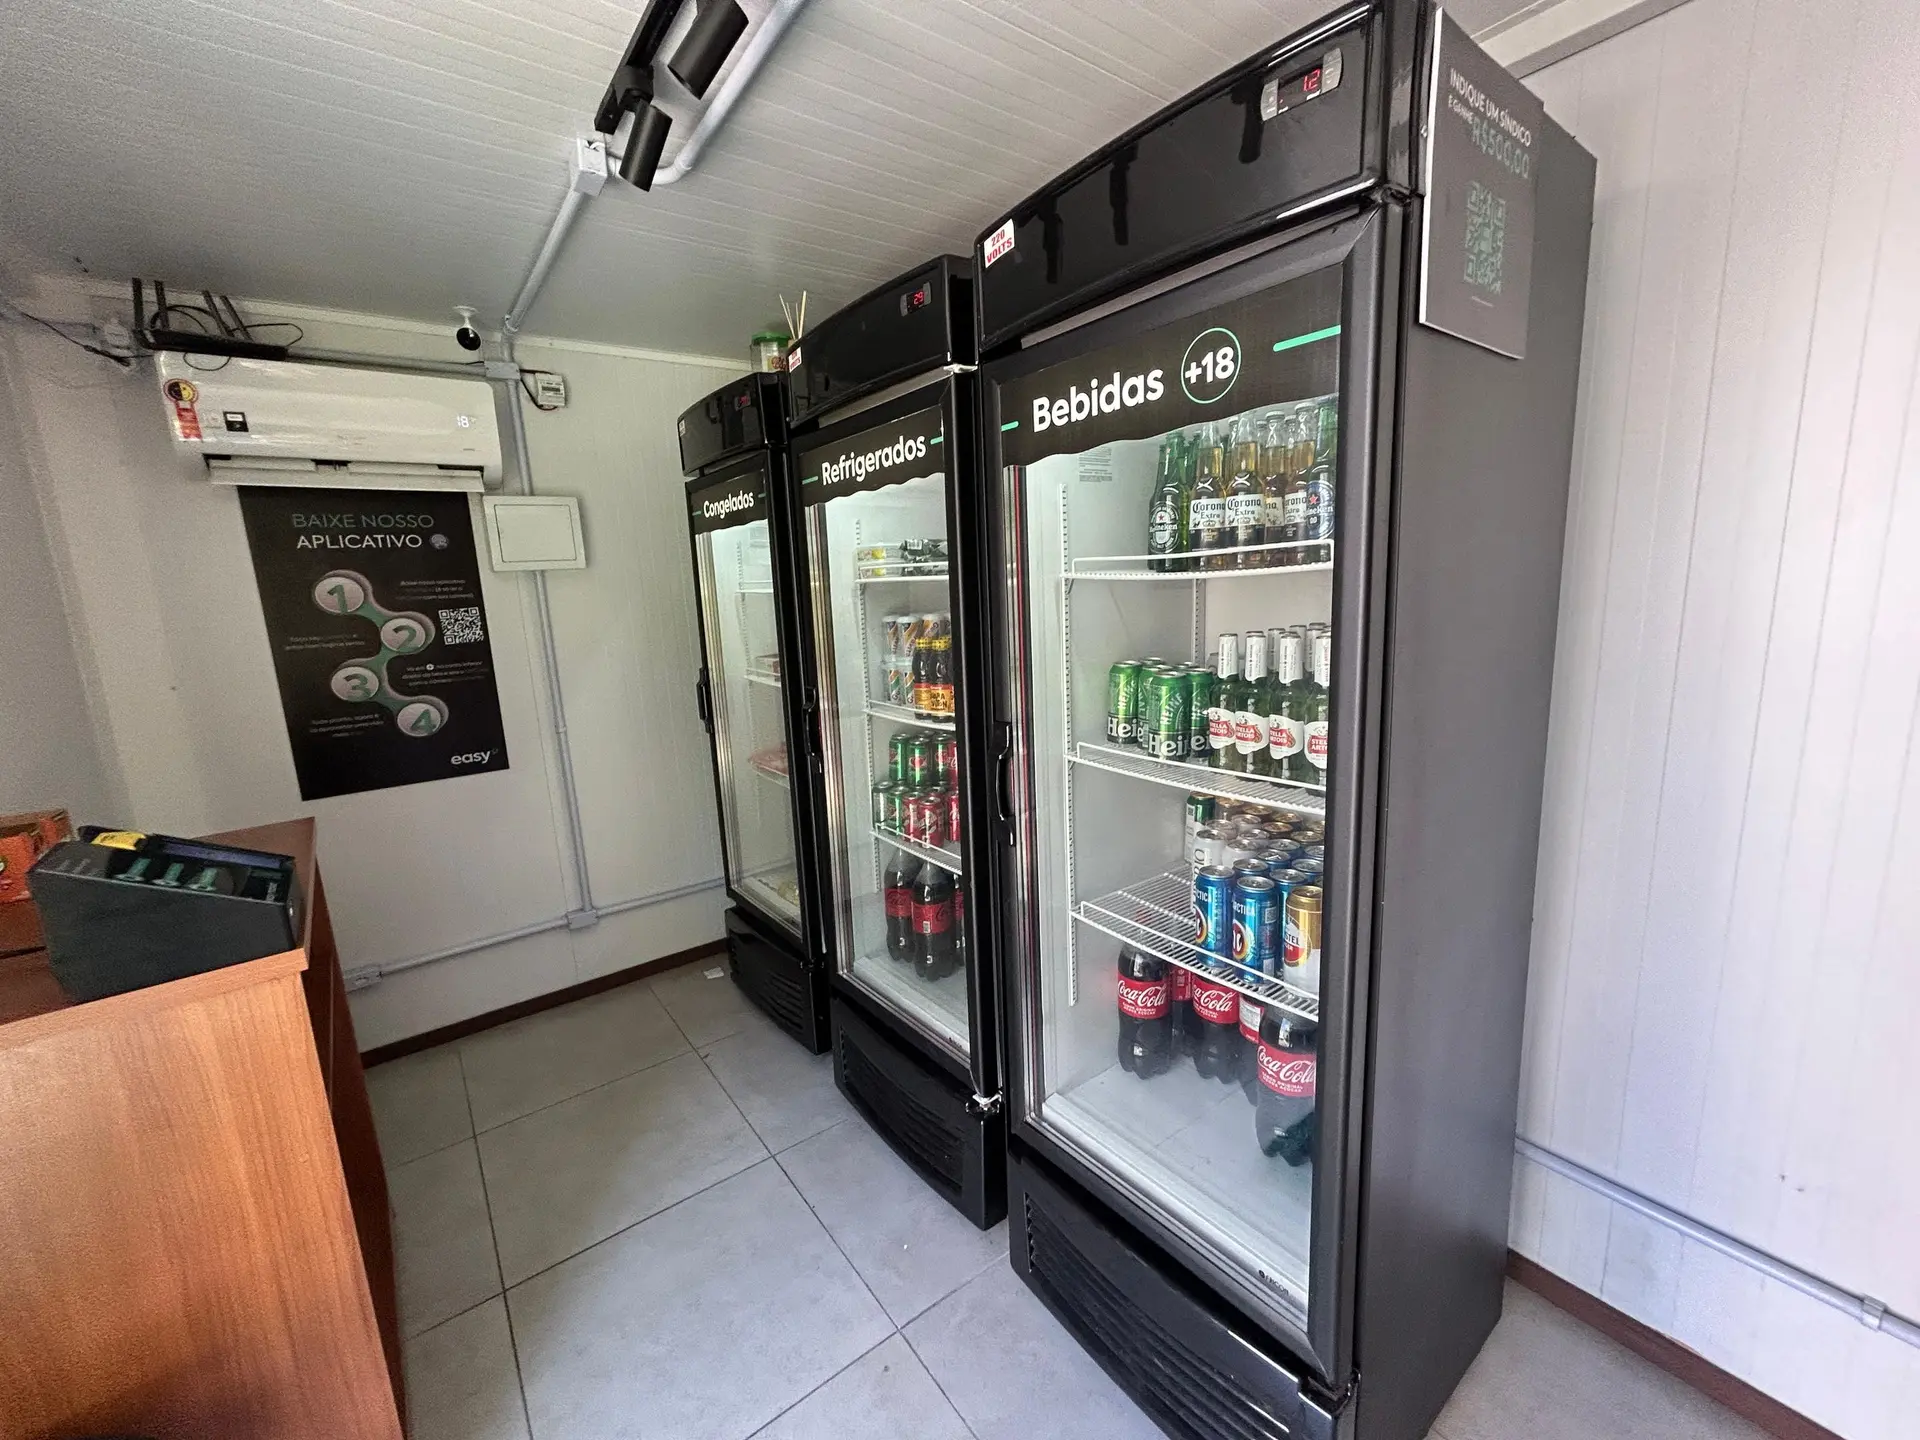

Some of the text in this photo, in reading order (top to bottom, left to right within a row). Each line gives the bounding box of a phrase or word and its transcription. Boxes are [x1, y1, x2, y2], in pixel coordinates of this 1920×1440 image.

[1450, 67, 1531, 147] INDIQUE UM SÍNDICO
[986, 237, 1013, 264] VOLTS
[991, 228, 1006, 248] 220
[1033, 346, 1236, 433] Bebidas +18
[821, 434, 927, 486] Refrigerados
[703, 489, 755, 520] Congelados
[291, 513, 435, 529] BAIXE NOSSO
[296, 534, 423, 549] APLICATIVO
[326, 584, 349, 614] 1
[392, 624, 418, 651] 2
[343, 673, 372, 701] 3
[410, 708, 437, 734] 4
[450, 750, 491, 765] easy
[1118, 980, 1167, 1007] Coca-Cola
[1257, 1045, 1316, 1084] Coca-Cola
